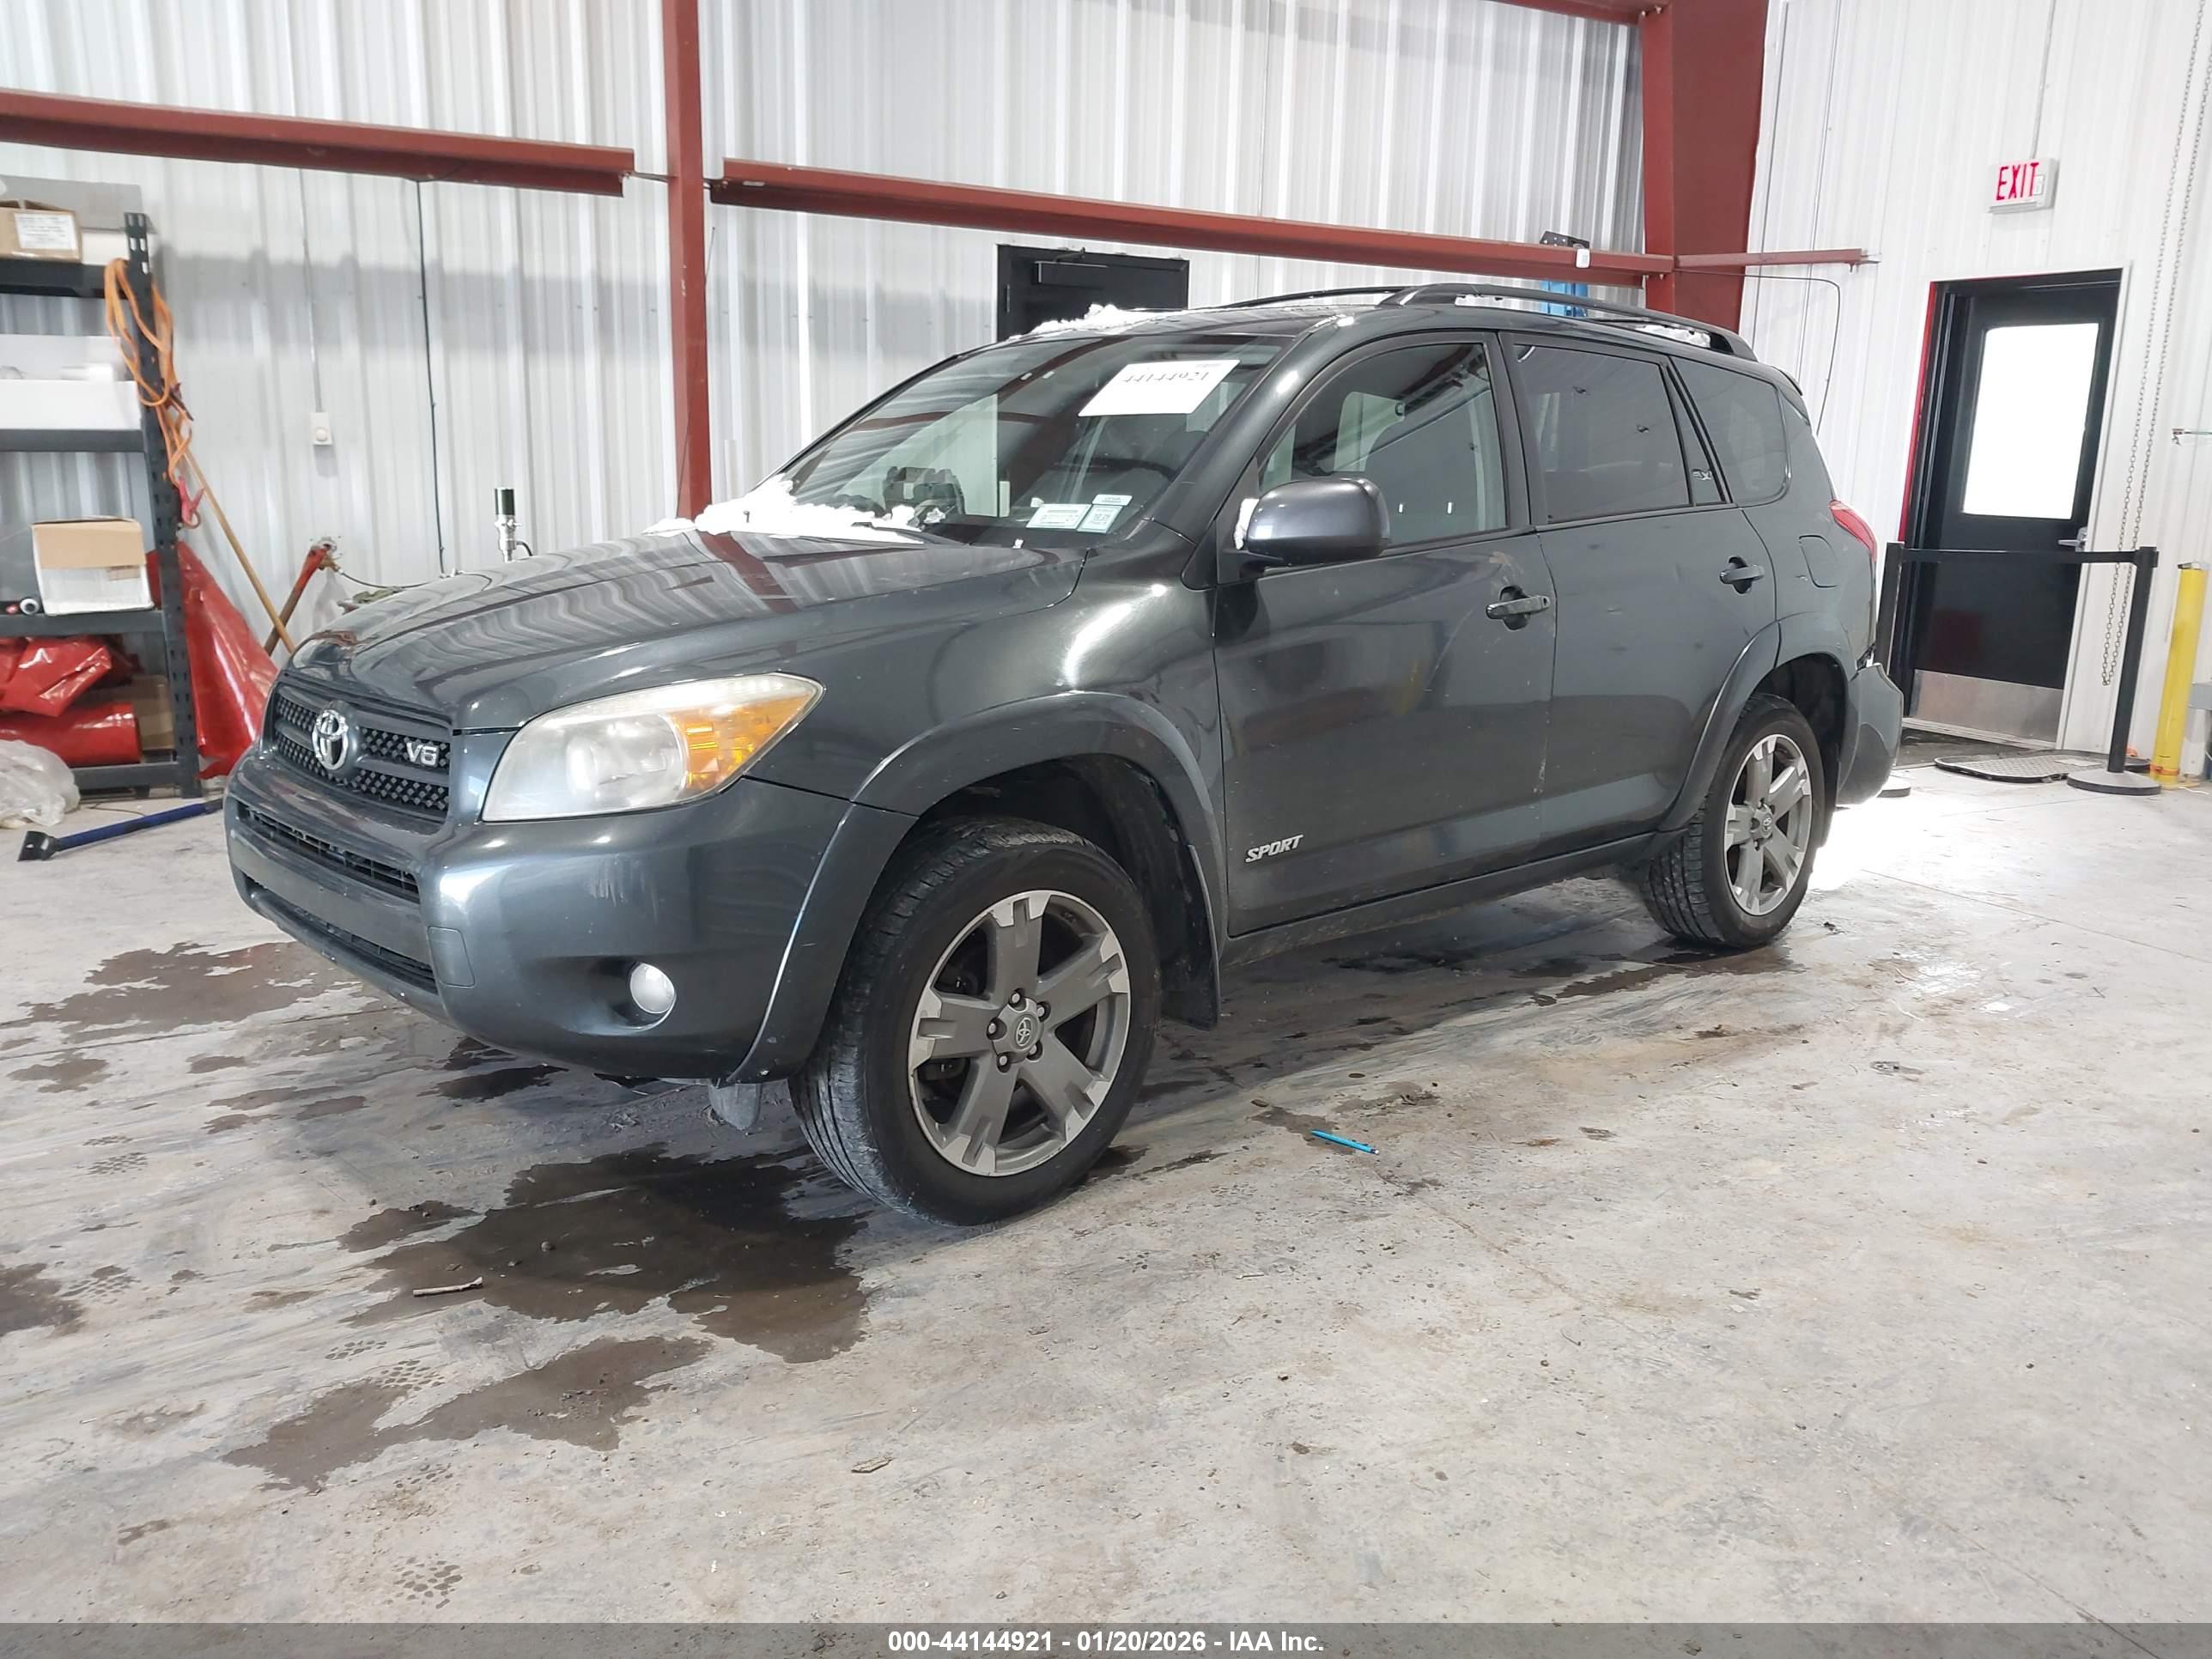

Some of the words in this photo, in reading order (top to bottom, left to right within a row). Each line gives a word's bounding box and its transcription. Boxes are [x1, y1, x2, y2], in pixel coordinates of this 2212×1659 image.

[1996, 161, 2039, 201] EXIT
[406, 742, 438, 766] V6
[1245, 834, 1304, 863] SPORT
